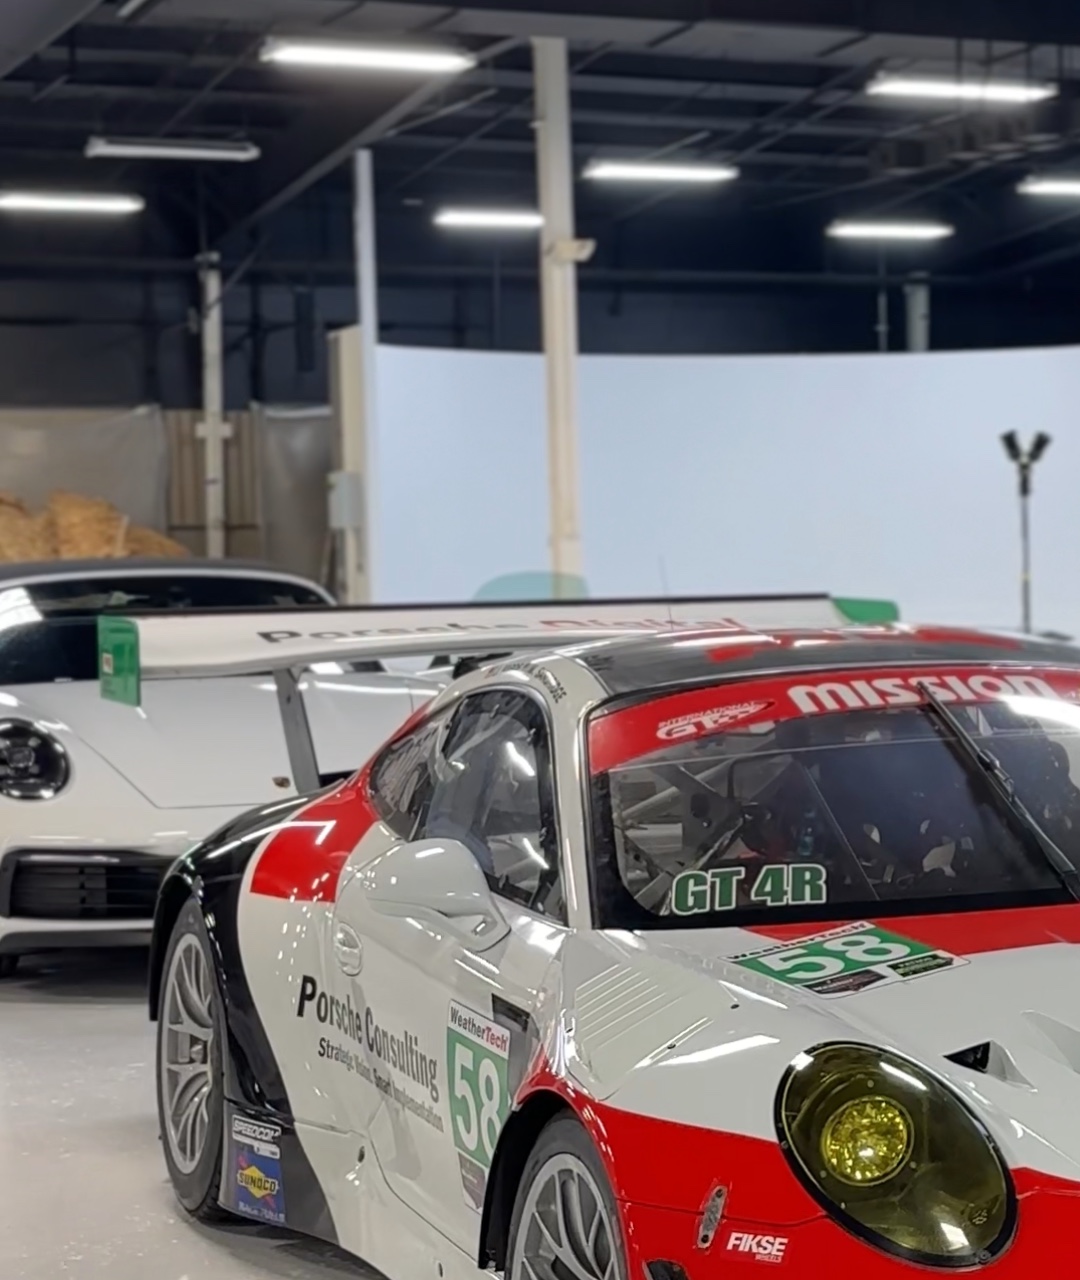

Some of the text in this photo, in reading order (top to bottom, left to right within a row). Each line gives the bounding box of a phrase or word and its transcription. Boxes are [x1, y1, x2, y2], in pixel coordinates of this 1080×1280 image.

[672, 863, 827, 916] GT 4R
[757, 934, 911, 979] 58
[297, 974, 440, 1104] Porsche Consulting
[450, 1005, 509, 1052] WeatherTech
[454, 1042, 501, 1160] 58
[239, 1172, 277, 1194] SUNOCO
[726, 1231, 789, 1256] FIKSE
